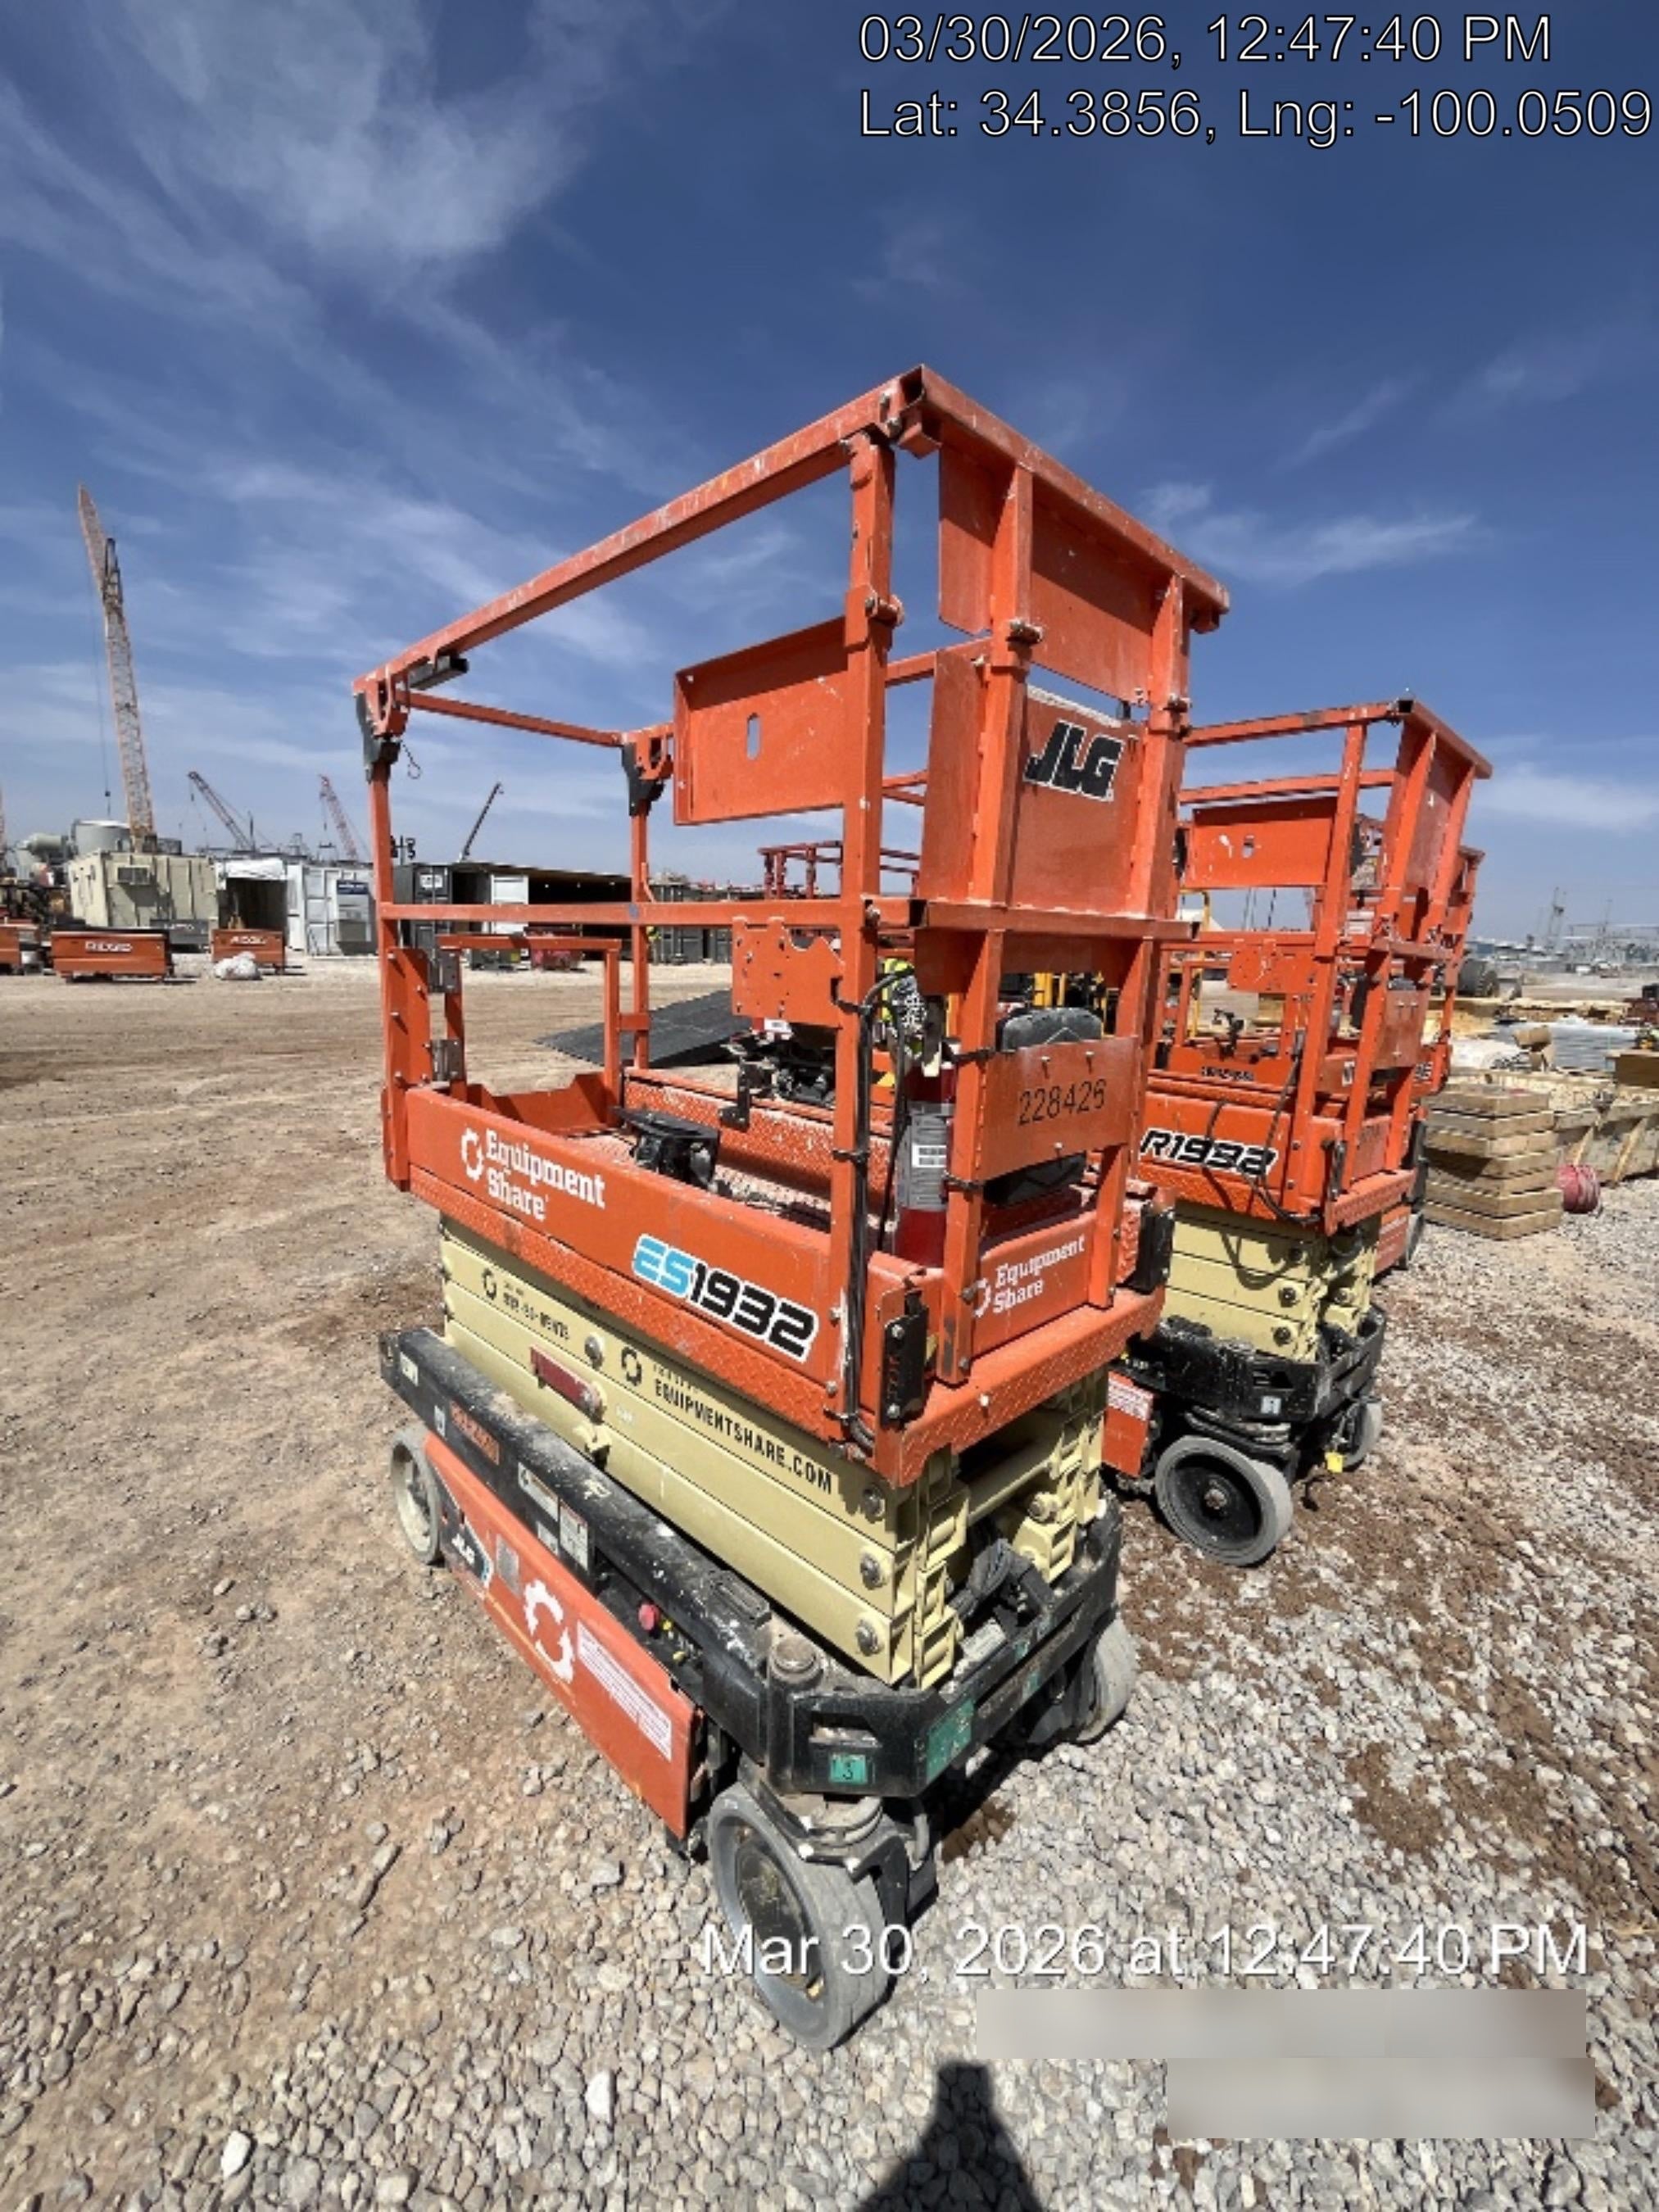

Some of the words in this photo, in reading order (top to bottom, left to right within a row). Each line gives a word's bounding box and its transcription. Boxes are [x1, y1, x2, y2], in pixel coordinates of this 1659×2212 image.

[1023, 719, 1125, 801] JLG
[1018, 1078, 1107, 1126] 228426
[485, 1128, 605, 1210] Equipment
[1139, 1126, 1279, 1177] R1932
[487, 1167, 546, 1222] Share
[995, 1235, 1086, 1289] Equipment
[632, 1235, 817, 1362] ES1932
[992, 1279, 1044, 1314] Share
[655, 1378, 832, 1494] EQUIPMENTSHARE.COM
